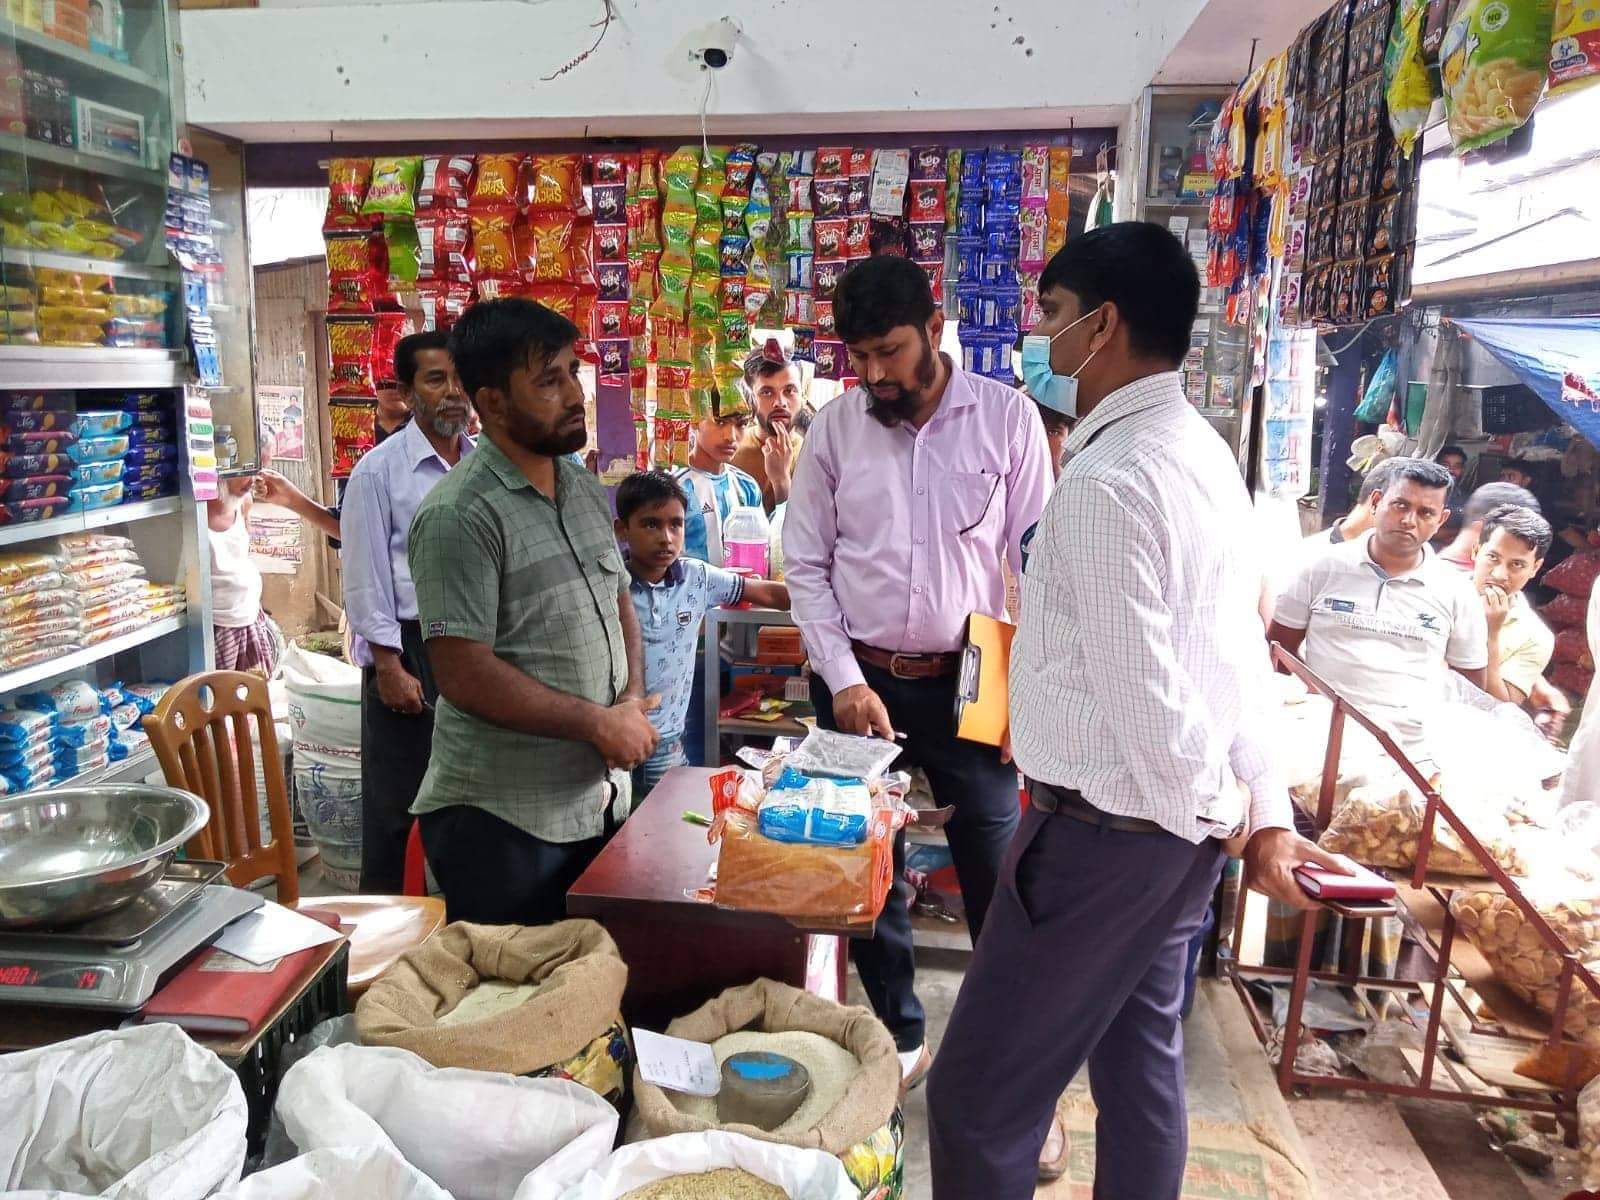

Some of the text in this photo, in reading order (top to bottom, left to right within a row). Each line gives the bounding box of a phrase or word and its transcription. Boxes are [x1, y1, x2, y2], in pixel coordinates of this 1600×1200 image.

[1487, 10, 1501, 22] NO
[476, 178, 504, 196] SPICY
[535, 186, 562, 203] SPICY
[478, 254, 504, 271] SPICY
[535, 262, 562, 279] SPICY
